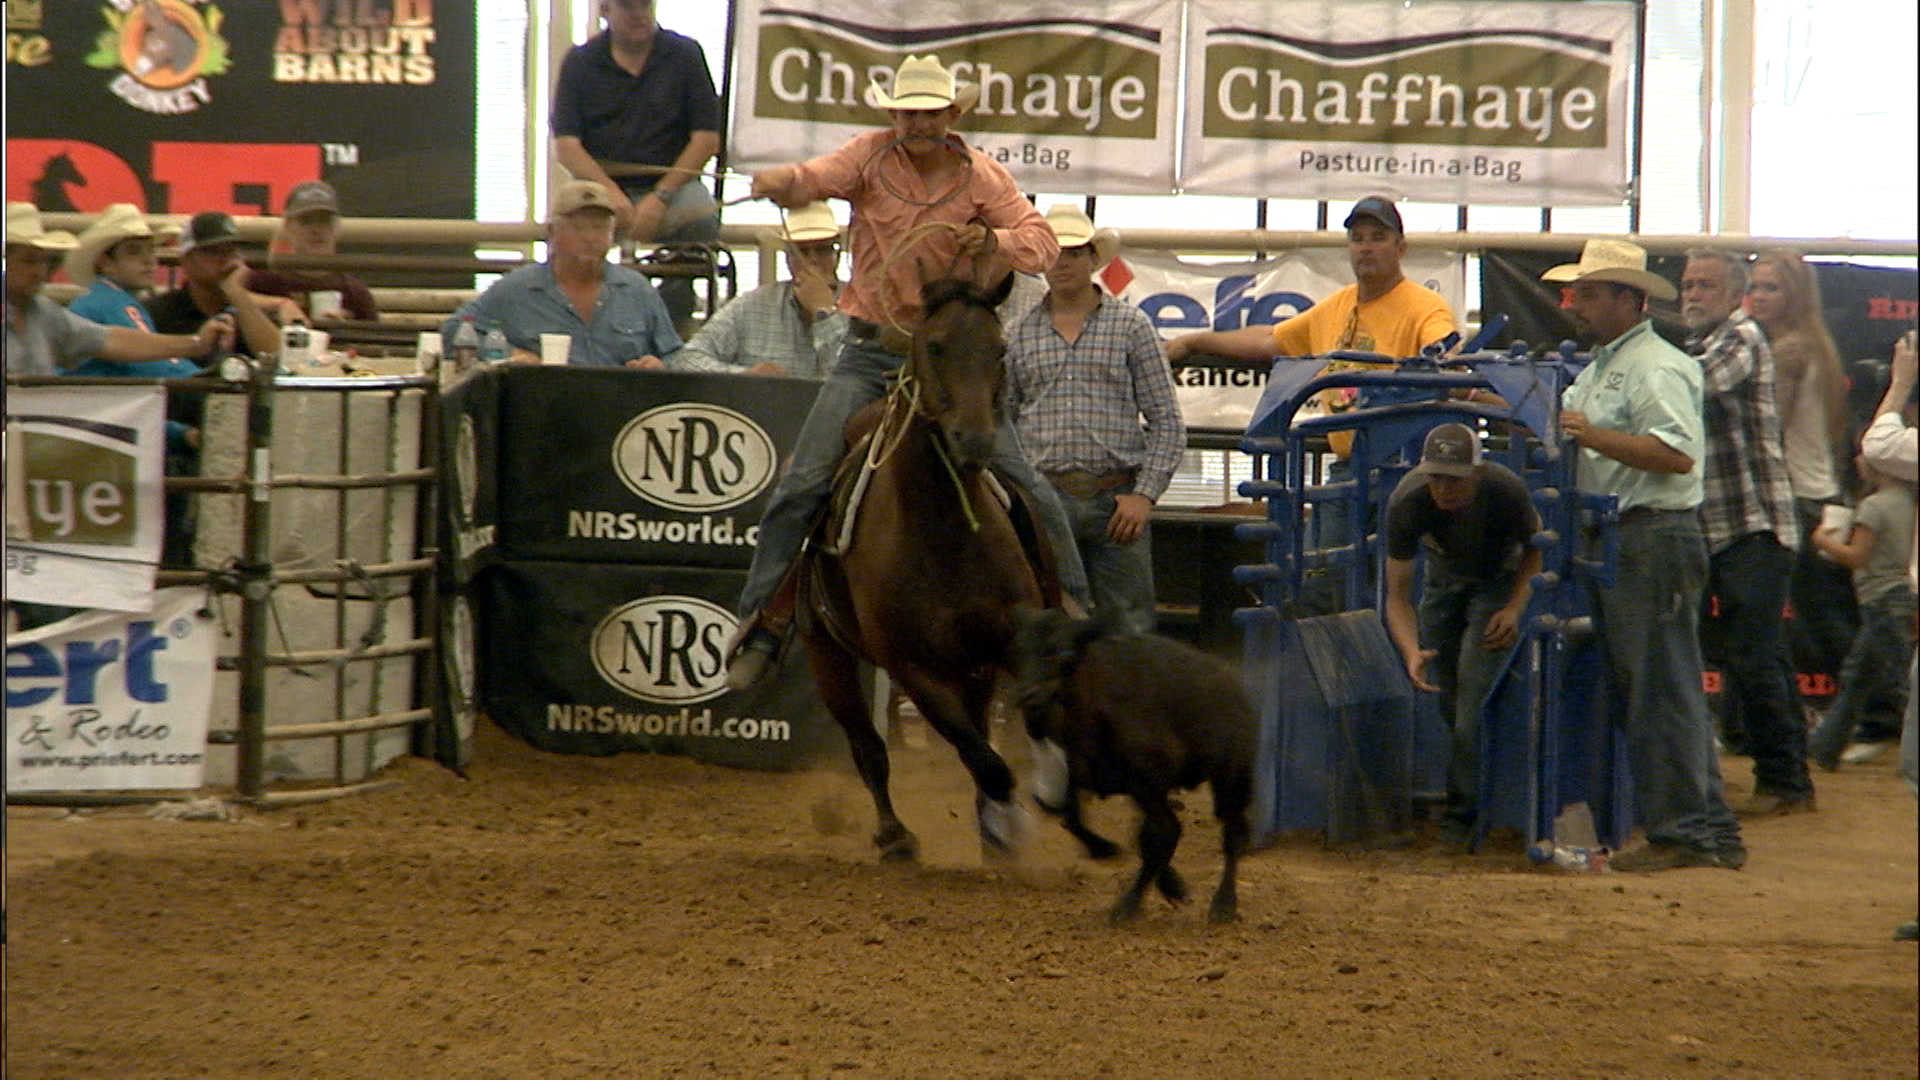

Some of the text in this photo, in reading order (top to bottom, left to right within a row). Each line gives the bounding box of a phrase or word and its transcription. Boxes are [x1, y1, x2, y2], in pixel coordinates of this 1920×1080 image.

[274, 26, 436, 54] ABOUT
[274, 53, 436, 84] BARNS
[769, 46, 1146, 130] Chafhaye
[1216, 66, 1597, 143] Chaffhaye
[641, 416, 746, 497] NRS
[618, 609, 724, 689] NRS
[66, 708, 170, 747] Rodeo
[546, 703, 791, 741] NRSworld.com
